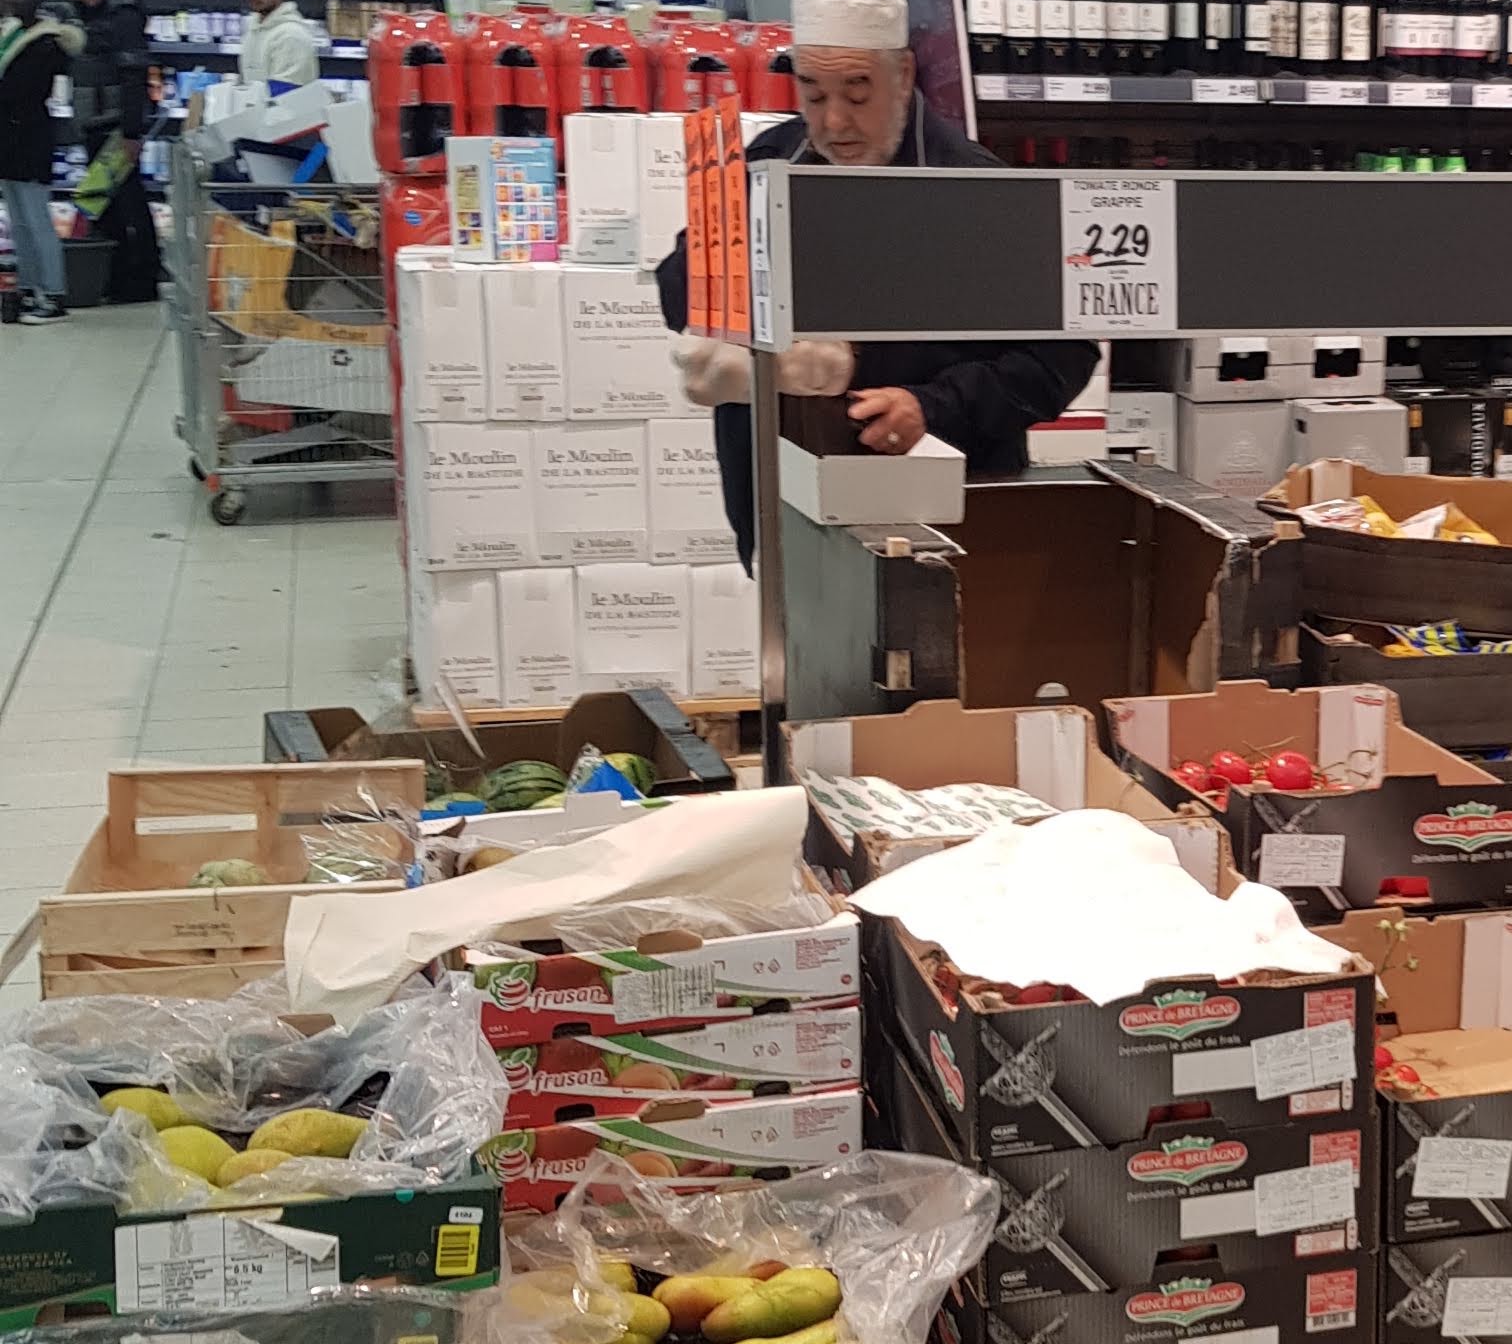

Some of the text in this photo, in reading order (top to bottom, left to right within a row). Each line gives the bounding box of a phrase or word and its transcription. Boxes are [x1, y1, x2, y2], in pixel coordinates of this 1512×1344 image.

[1073, 180, 1162, 192] TOMATE RONDE
[1090, 196, 1144, 208] GRAPPE
[1085, 223, 1150, 257] 2.29
[579, 300, 597, 316] le
[1079, 282, 1160, 316] FRANCE
[428, 450, 517, 465] le Moulin
[547, 448, 634, 463] le Moulin
[663, 447, 718, 462] le Mou
[591, 591, 676, 605] le Moulin
[529, 986, 603, 1013] frusan
[1125, 1009, 1164, 1025] PRINCE
[1177, 1003, 1235, 1018] BRETAGNE
[532, 1069, 604, 1093] frusan
[1132, 1157, 1171, 1172] PRINCE
[1185, 1147, 1241, 1164] BRETAGNE
[1130, 1297, 1169, 1312] PRINCE
[1183, 1288, 1238, 1306] BRETAGNE
